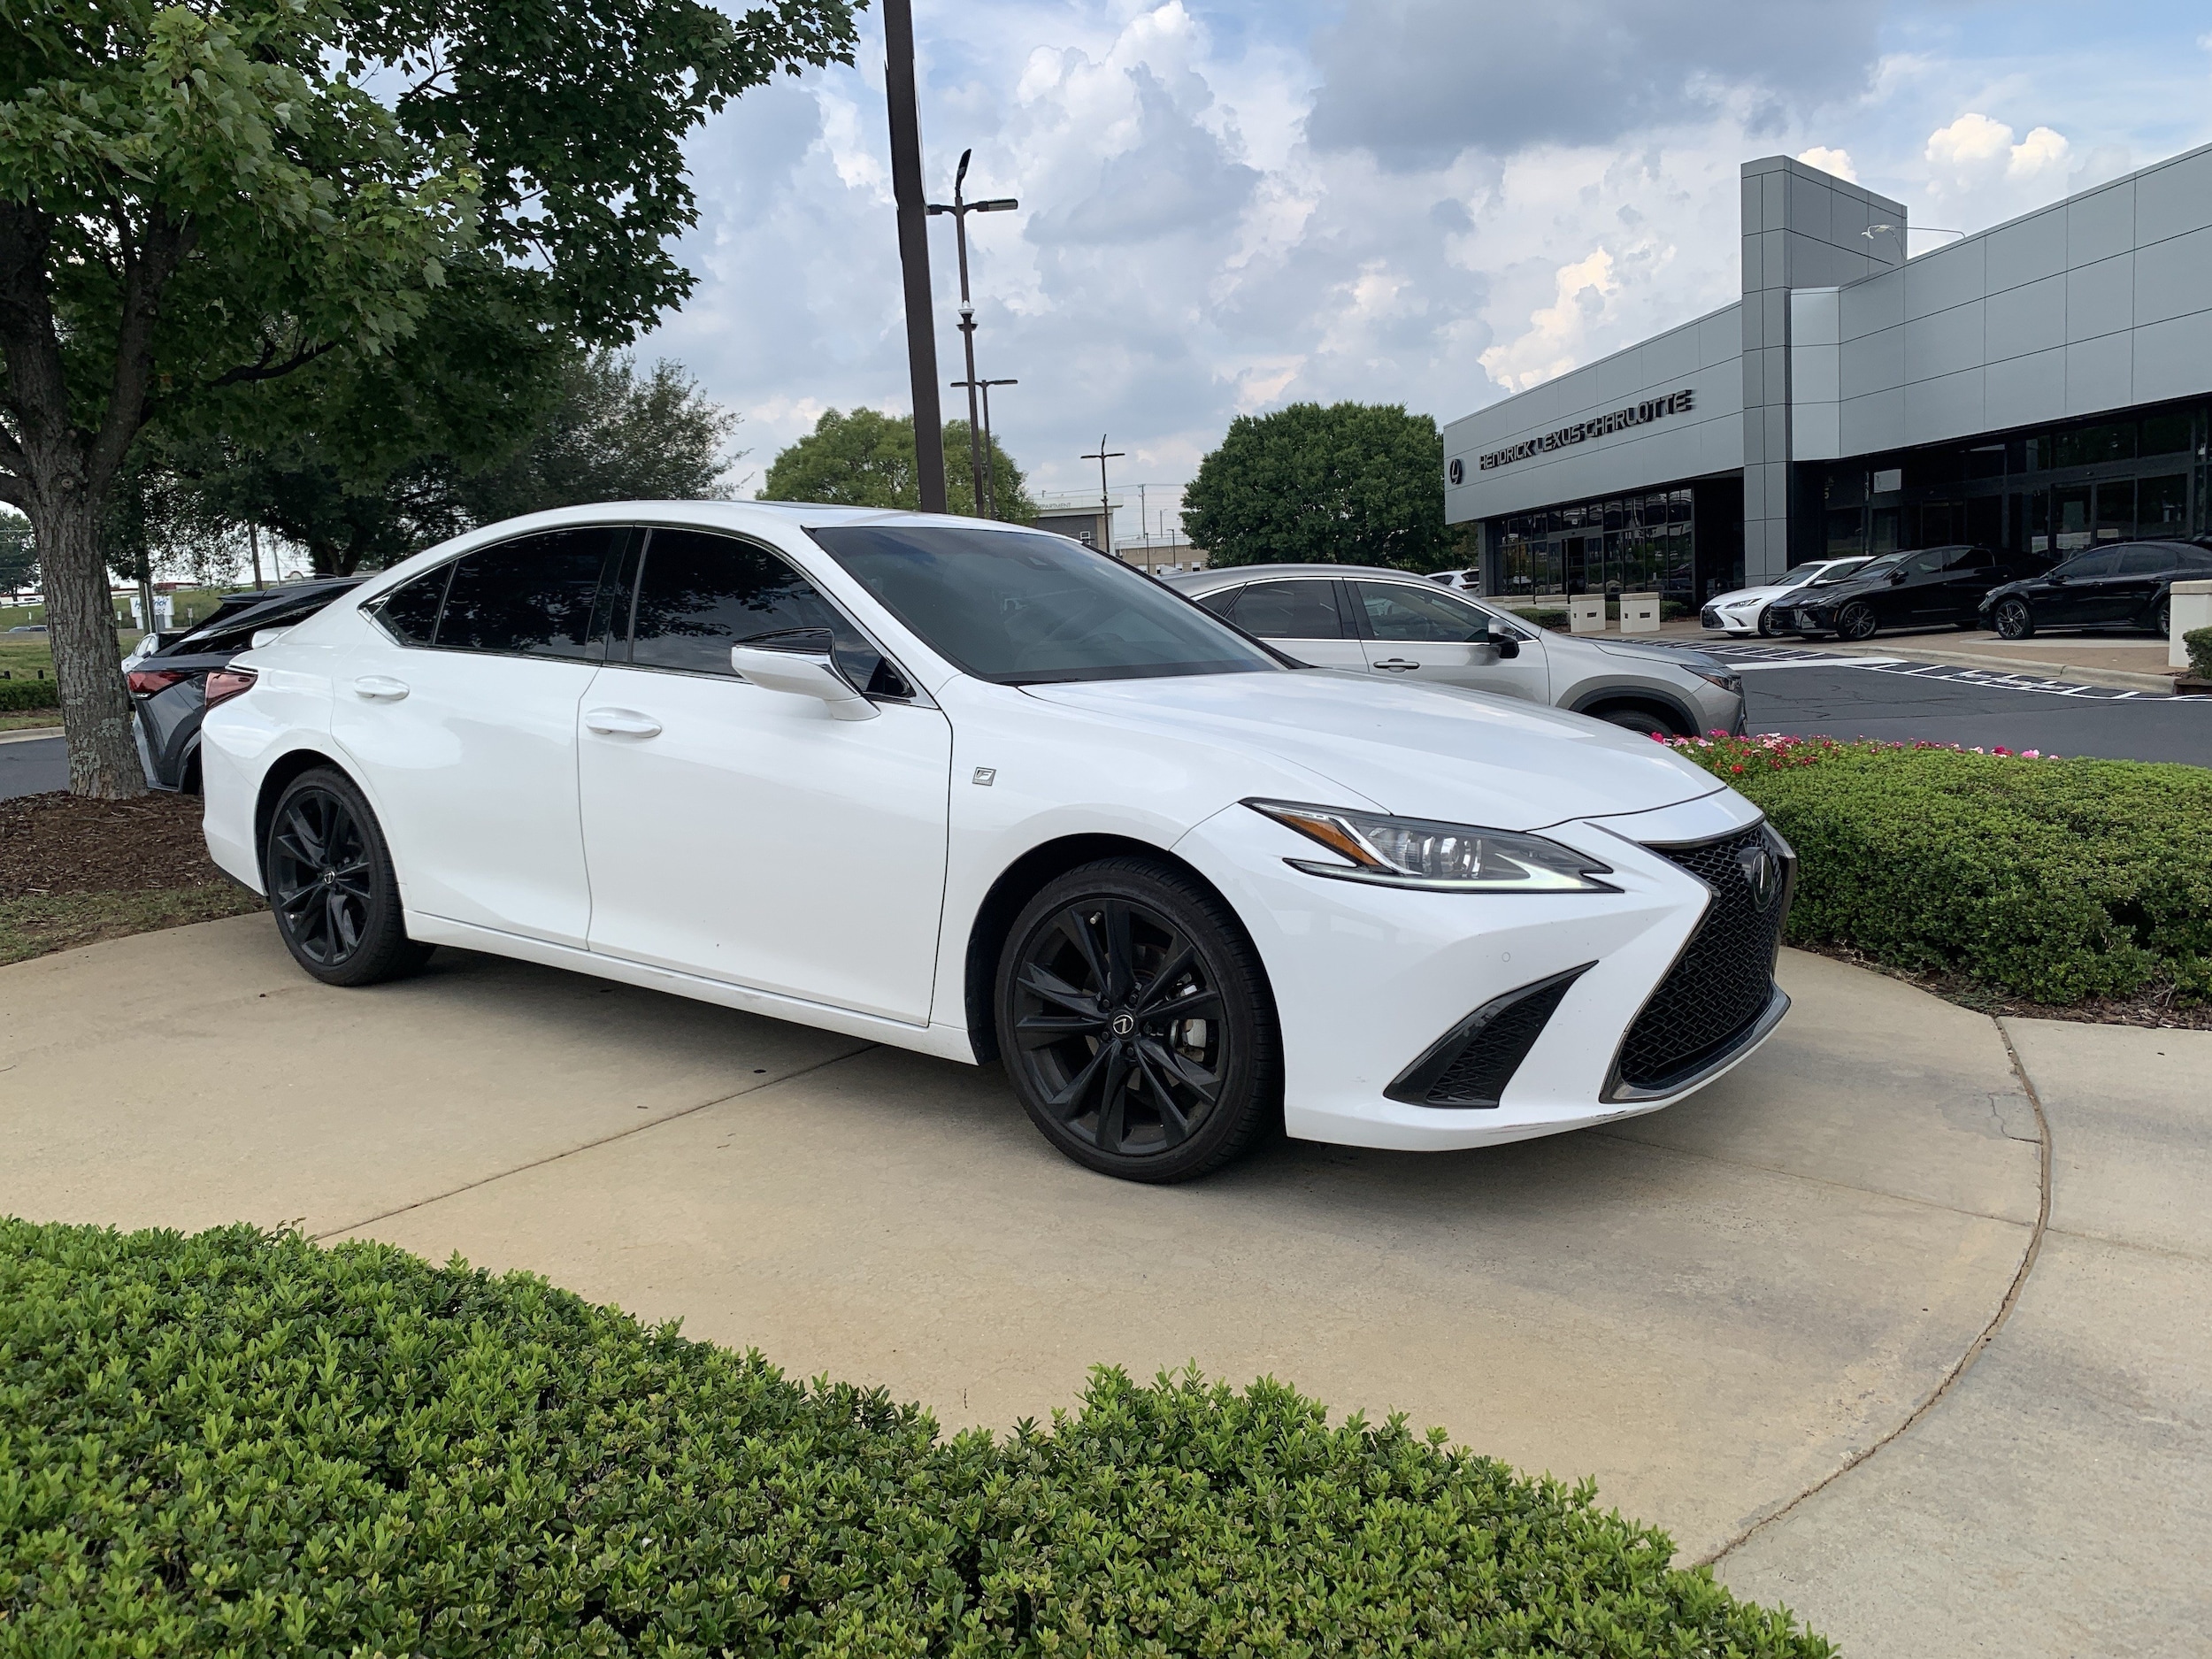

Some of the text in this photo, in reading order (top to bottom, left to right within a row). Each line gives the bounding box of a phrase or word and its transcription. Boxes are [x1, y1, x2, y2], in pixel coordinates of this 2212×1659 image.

[1479, 388, 1696, 471] HENDRICK LEXUS CHARLOTTE
